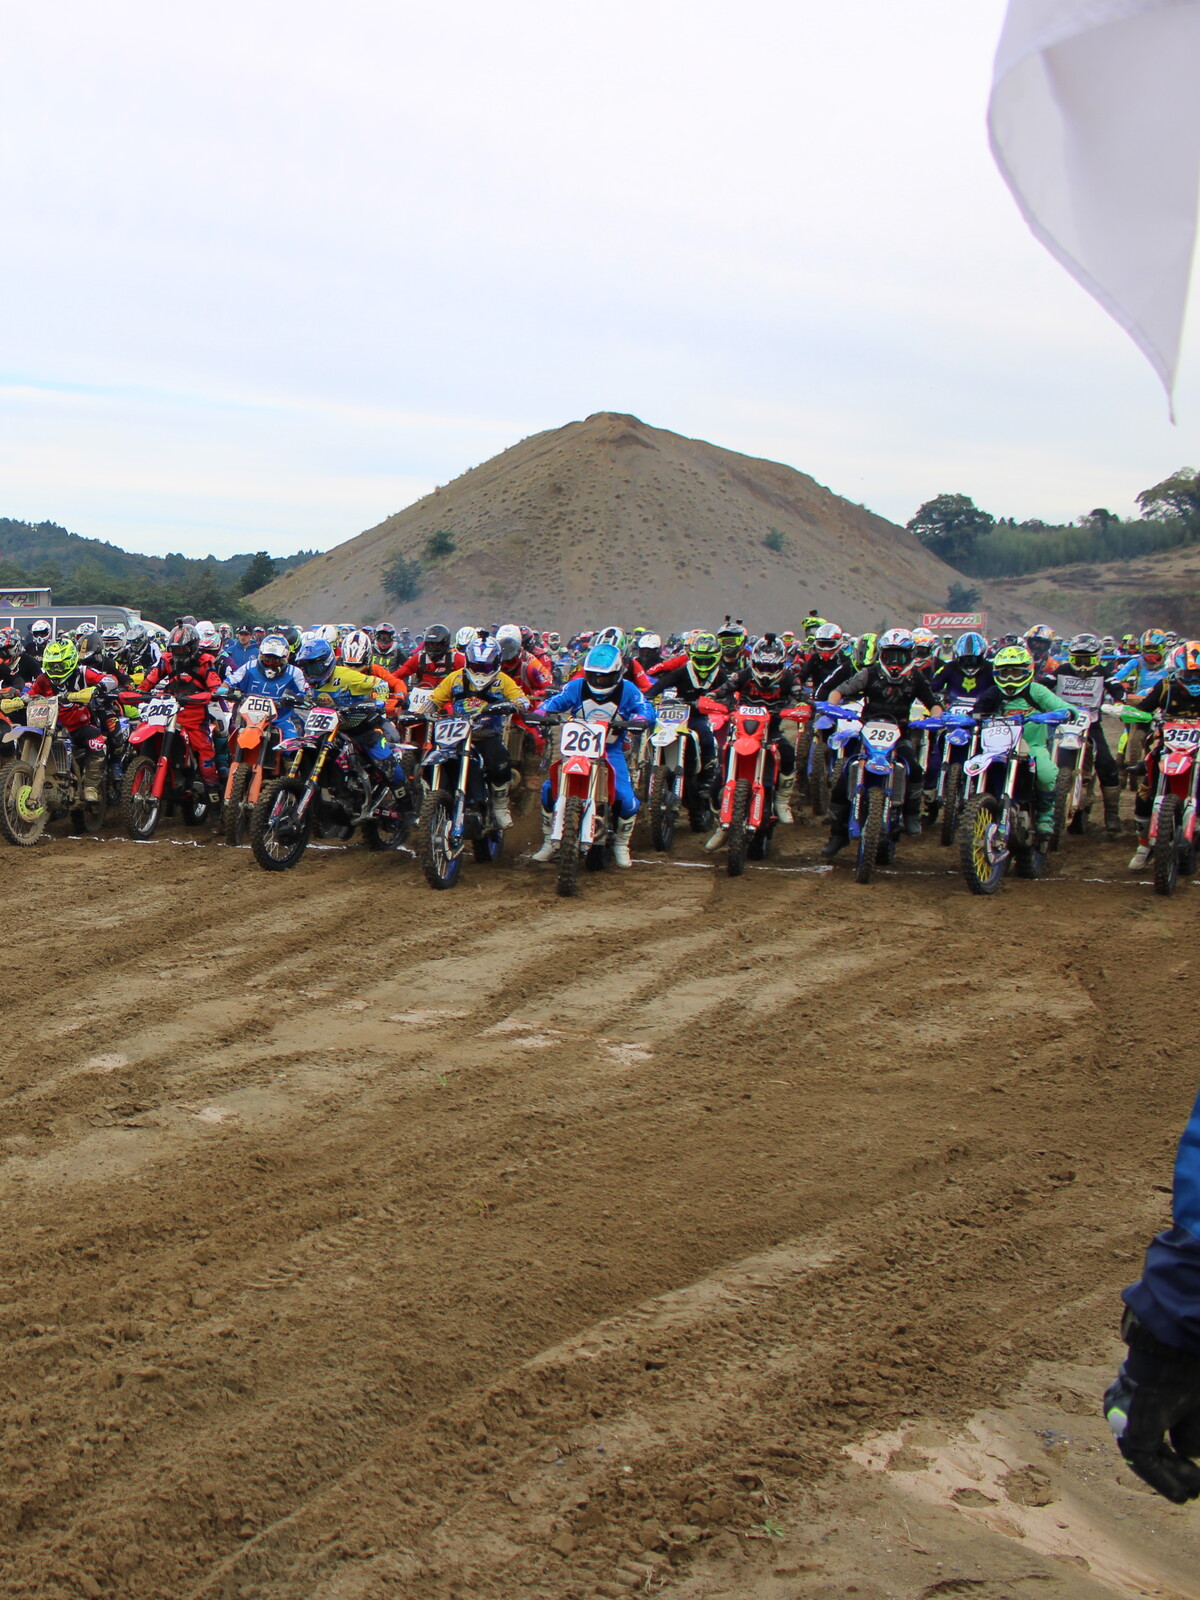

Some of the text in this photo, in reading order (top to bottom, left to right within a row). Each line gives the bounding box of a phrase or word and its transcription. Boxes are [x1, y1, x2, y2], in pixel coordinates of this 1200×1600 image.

[930, 616, 975, 626] JNCC
[371, 656, 391, 666] FLY
[252, 680, 286, 696] FLY
[149, 704, 173, 716] 206
[248, 699, 270, 711] 266
[742, 707, 761, 715] 260
[659, 710, 684, 721] 405
[306, 714, 334, 730] 286
[437, 722, 467, 739] 212
[869, 729, 895, 742] 293
[988, 727, 1010, 738] 289
[564, 731, 603, 753] 261
